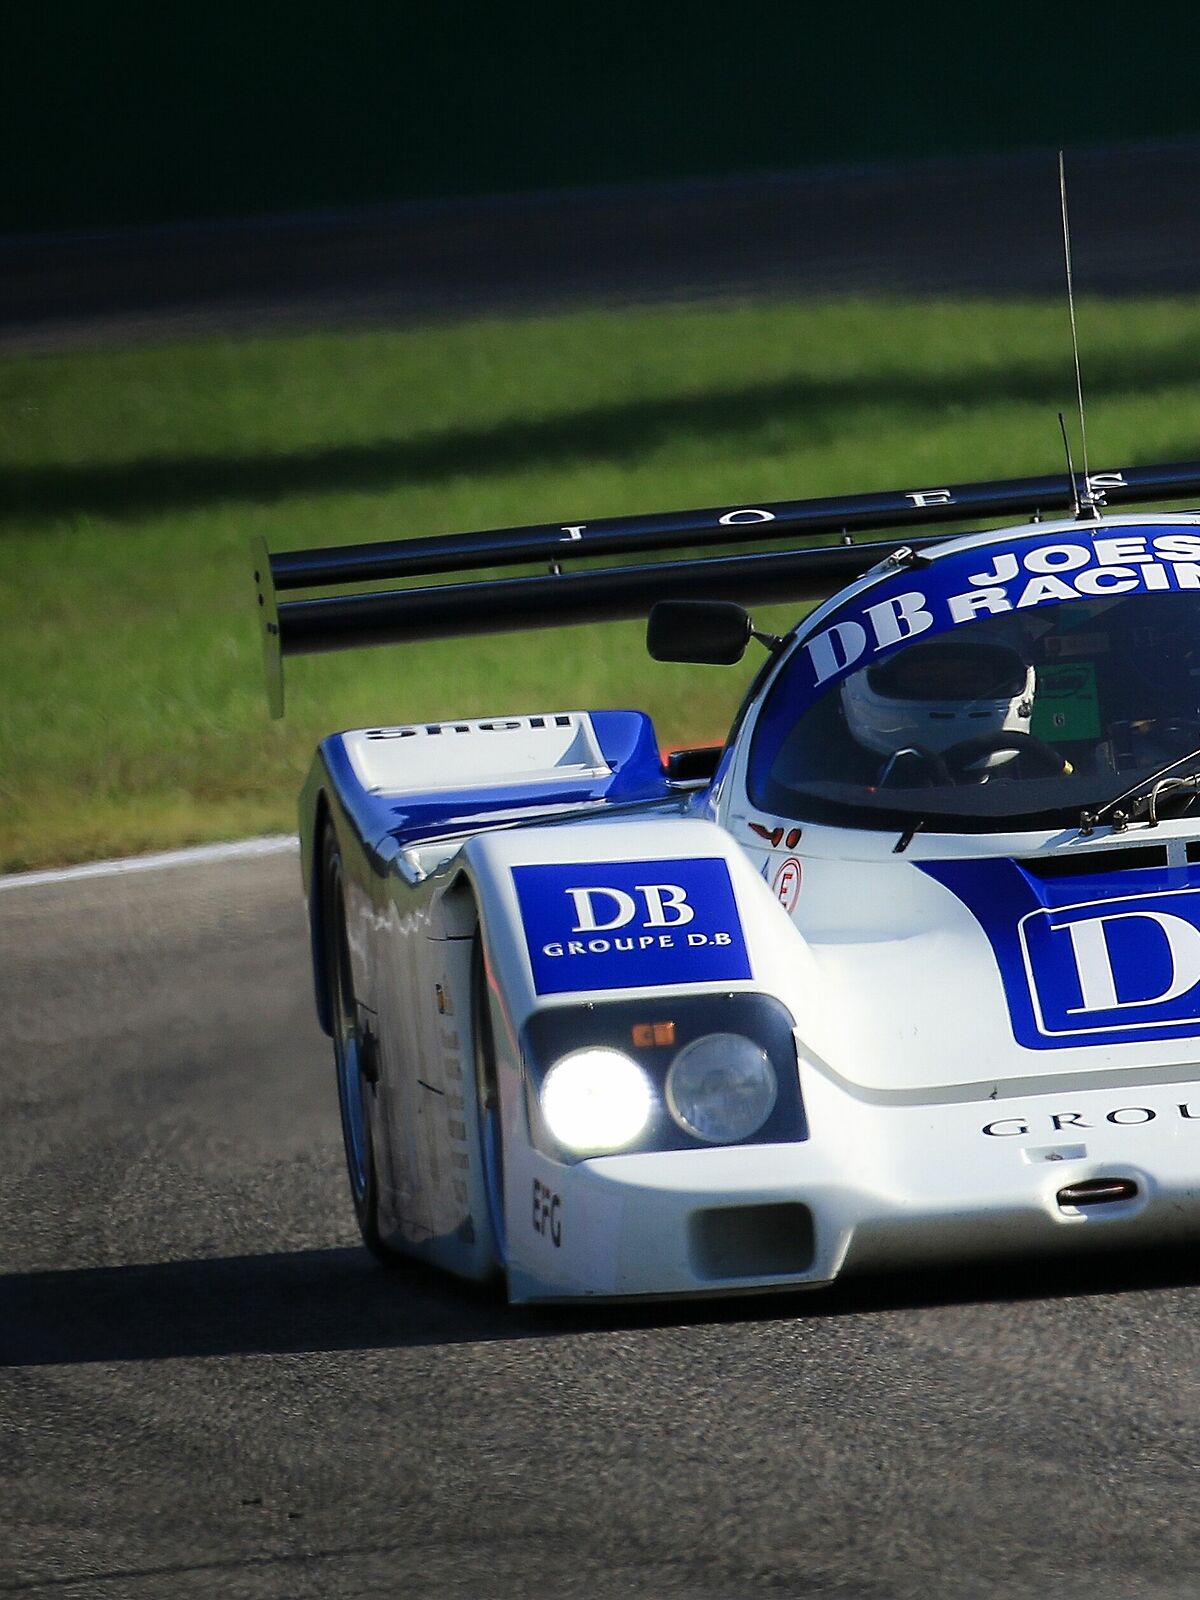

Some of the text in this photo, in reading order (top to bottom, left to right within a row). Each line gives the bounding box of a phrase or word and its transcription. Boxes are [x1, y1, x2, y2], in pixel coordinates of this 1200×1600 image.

[802, 591, 934, 687] DB
[565, 884, 695, 932] DB
[542, 932, 732, 957] GROUPE D.B
[532, 1177, 561, 1249] EFG
